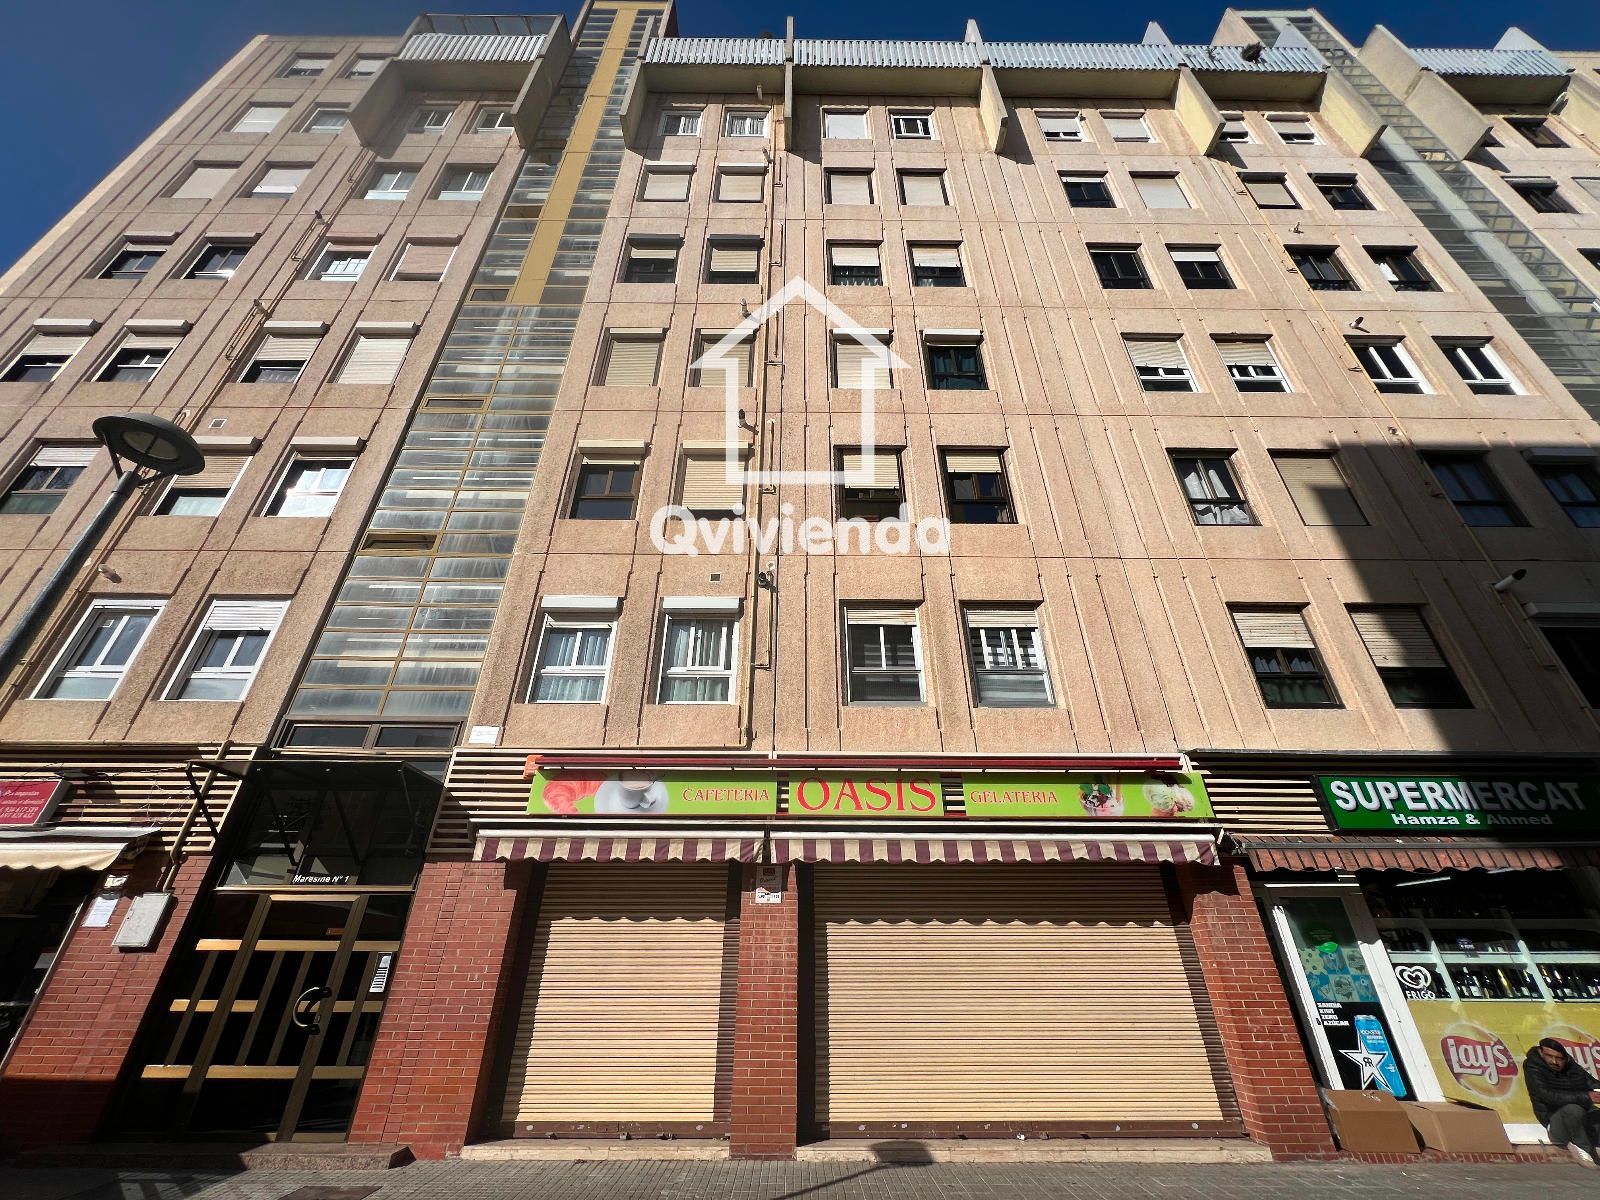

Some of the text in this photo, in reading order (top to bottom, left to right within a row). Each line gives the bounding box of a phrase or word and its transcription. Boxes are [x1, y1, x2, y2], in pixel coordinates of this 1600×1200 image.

[682, 787, 770, 803] CAFETERIA
[796, 776, 937, 813] OASIS
[970, 790, 1059, 805] GELATERIA
[1330, 780, 1586, 812] SUPERMERCAT
[1391, 813, 1553, 826] Hamza & Ahmed
[344, 875, 350, 883] 1
[1406, 991, 1436, 1000] FRIGO
